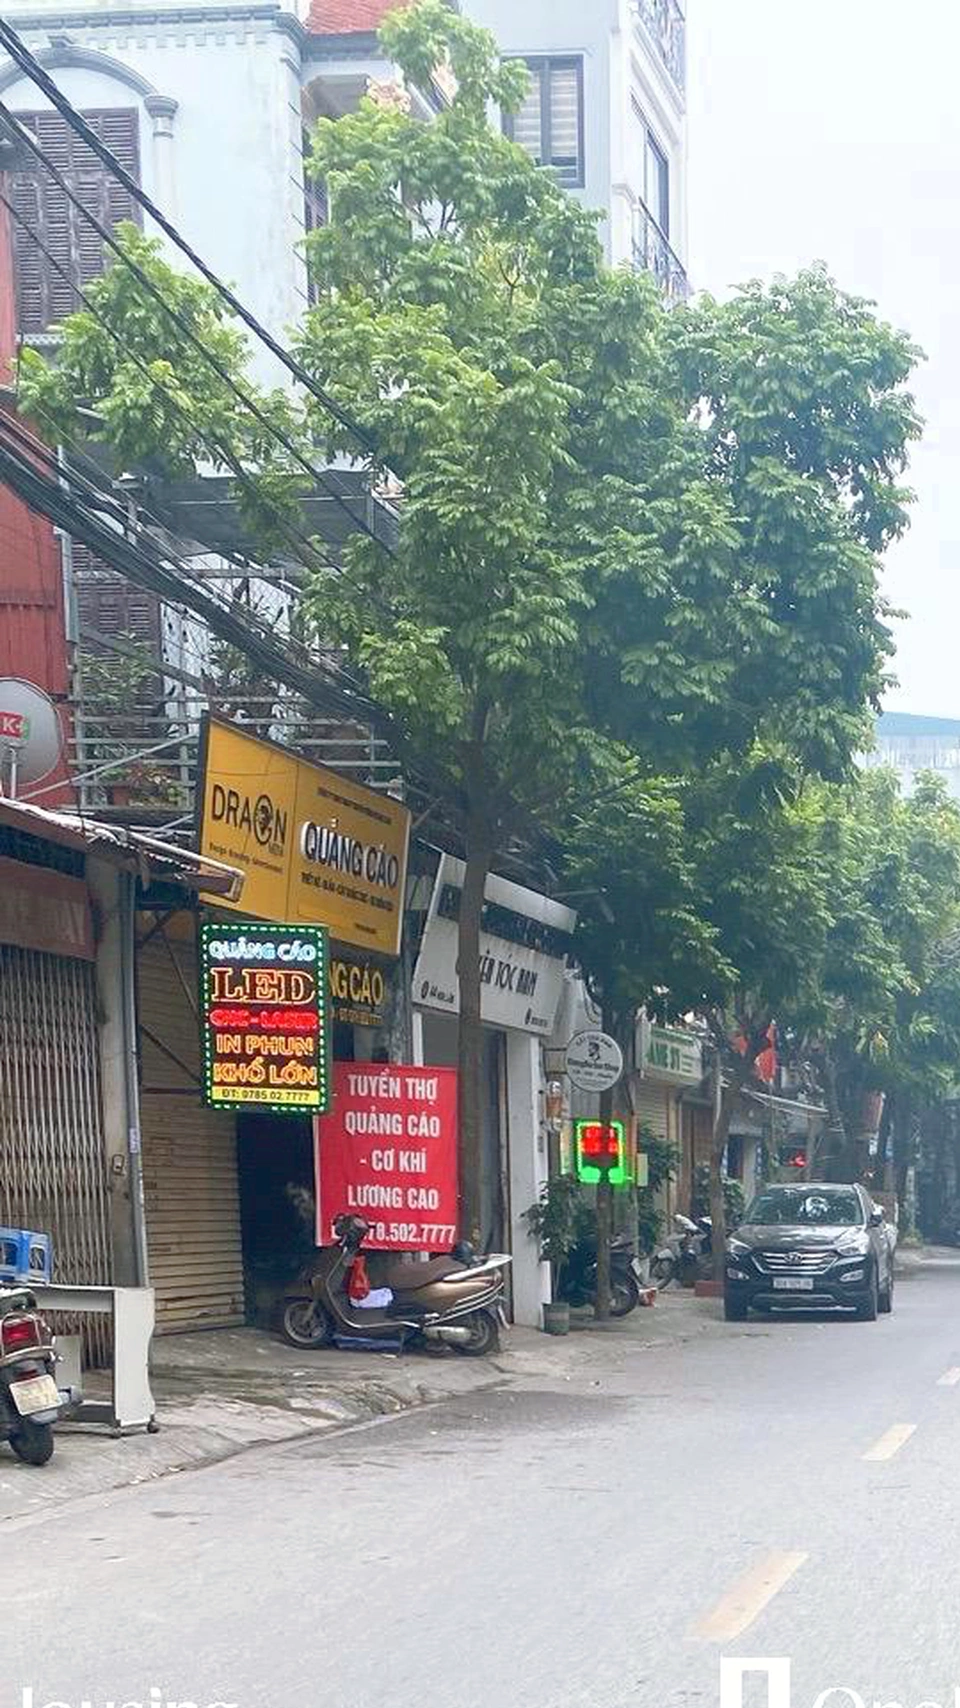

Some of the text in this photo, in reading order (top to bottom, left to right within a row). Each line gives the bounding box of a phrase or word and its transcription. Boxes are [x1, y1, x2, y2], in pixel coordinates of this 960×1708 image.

[301, 816, 364, 877] QUẢNG
[364, 843, 399, 890] CÁO
[209, 937, 317, 961] QUẢNG CÁO
[210, 967, 316, 1005] LED
[217, 1034, 314, 1057] IN PHUN
[213, 1056, 318, 1085] KHỔ LỚN
[348, 1068, 438, 1106] TUYỂN THỢ
[345, 1105, 440, 1138] QUẢNG CÁO
[371, 1148, 395, 1172] CƠ
[399, 1147, 427, 1174] KHÍ
[347, 1184, 440, 1210] LƯƠNG CAO
